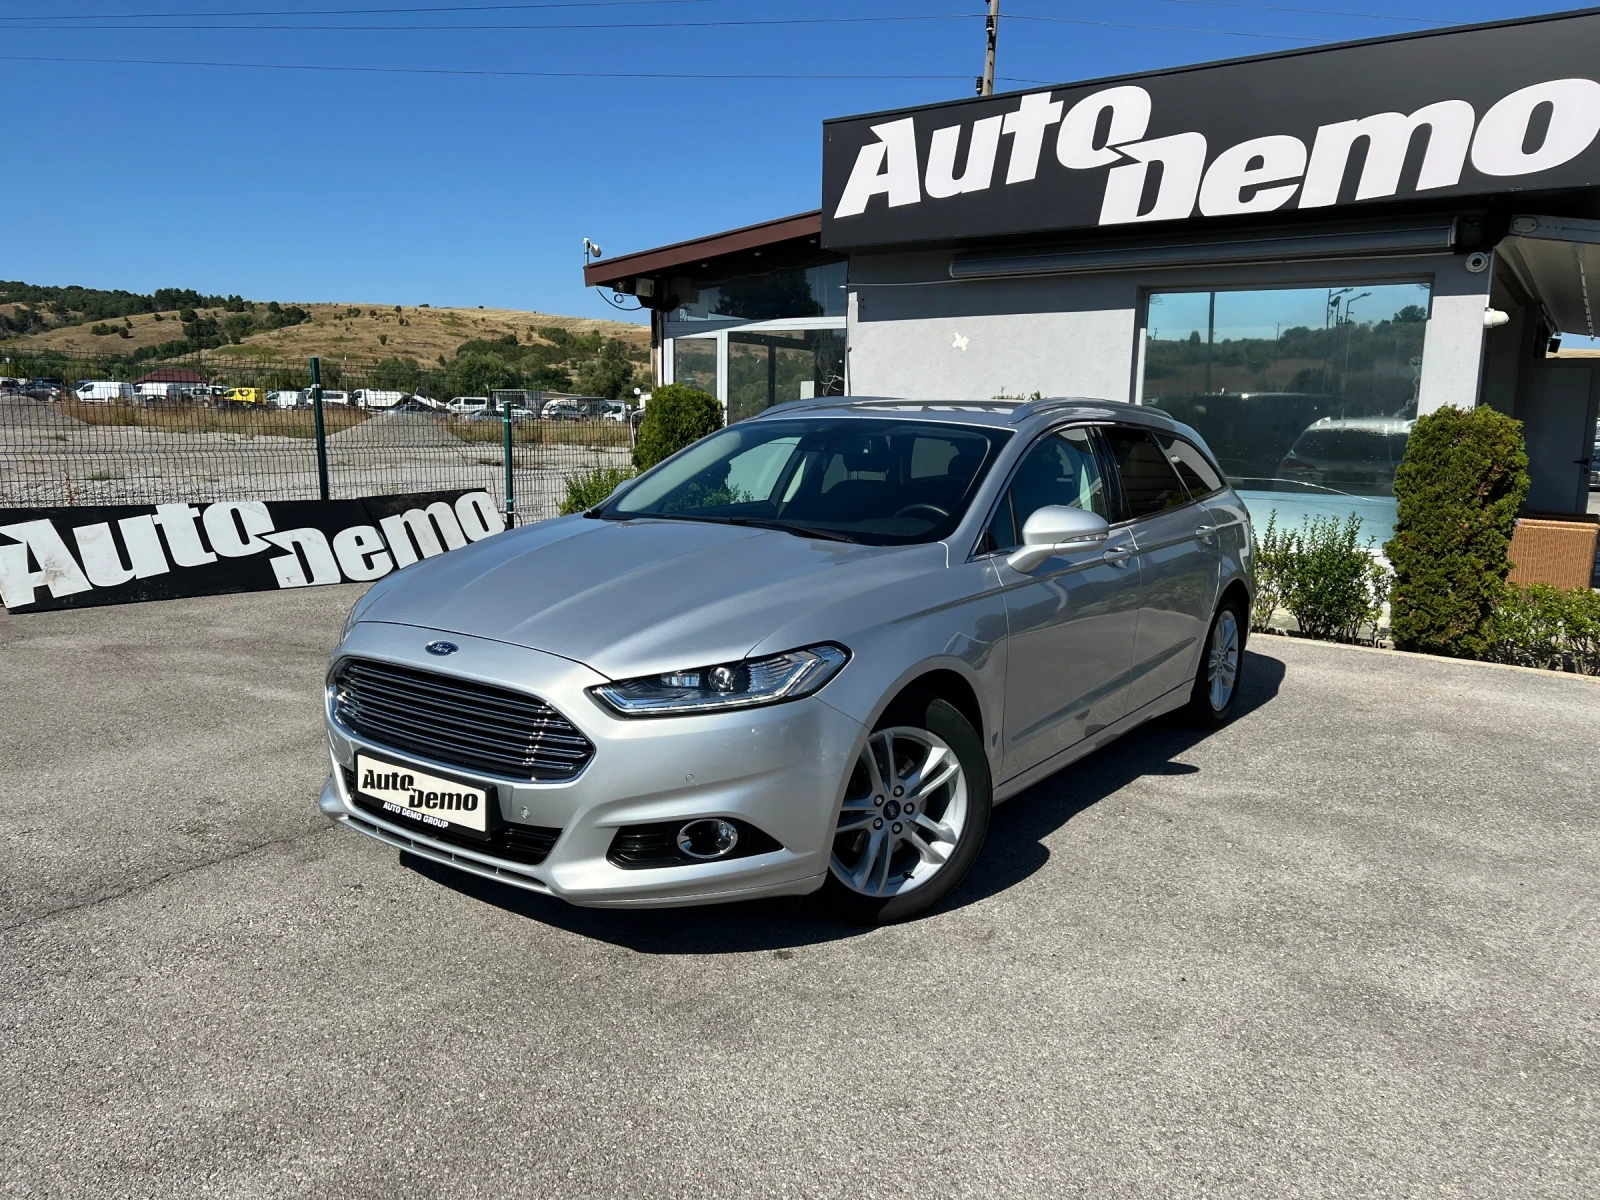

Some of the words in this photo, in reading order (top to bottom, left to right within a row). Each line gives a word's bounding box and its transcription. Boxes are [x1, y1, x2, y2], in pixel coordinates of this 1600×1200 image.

[834, 85, 1152, 219] Auto
[1099, 78, 1600, 225] Demo
[0, 500, 275, 608] Auto
[261, 491, 505, 588] Demo
[362, 769, 414, 791] Auto
[383, 802, 401, 814] AUTO
[401, 808, 422, 821] DEMO
[423, 815, 449, 829] GROUP
[409, 788, 478, 811] Demo
